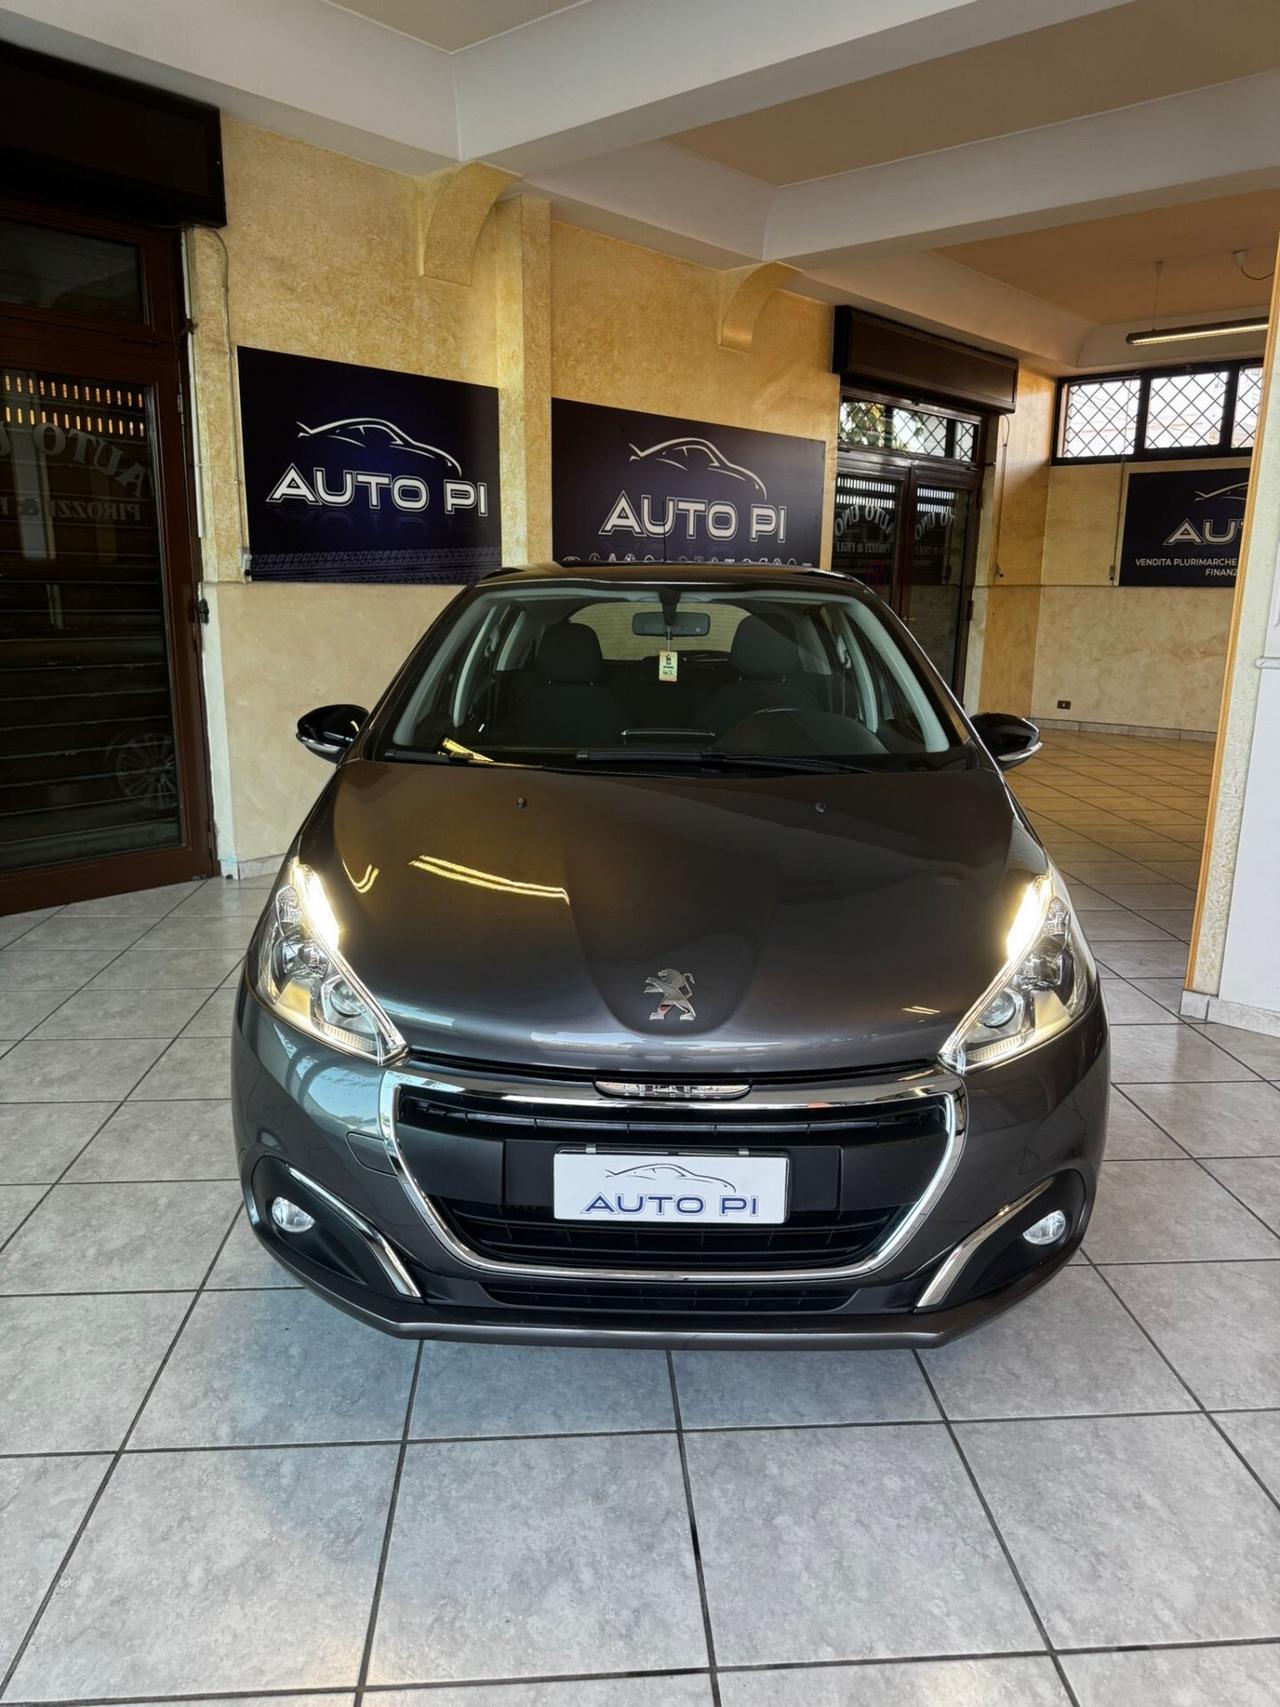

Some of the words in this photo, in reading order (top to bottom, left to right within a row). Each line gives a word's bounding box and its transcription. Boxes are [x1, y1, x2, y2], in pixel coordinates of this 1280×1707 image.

[266, 462, 430, 512] AUTO
[443, 479, 488, 517] PI
[598, 490, 738, 541] AUTO
[750, 504, 787, 543] PI
[1162, 518, 1244, 546] AU
[1135, 558, 1172, 567] VENDITA
[1173, 558, 1238, 567] PLURIMARCHE
[580, 1192, 706, 1216] AUTO
[719, 1195, 759, 1217] PI
